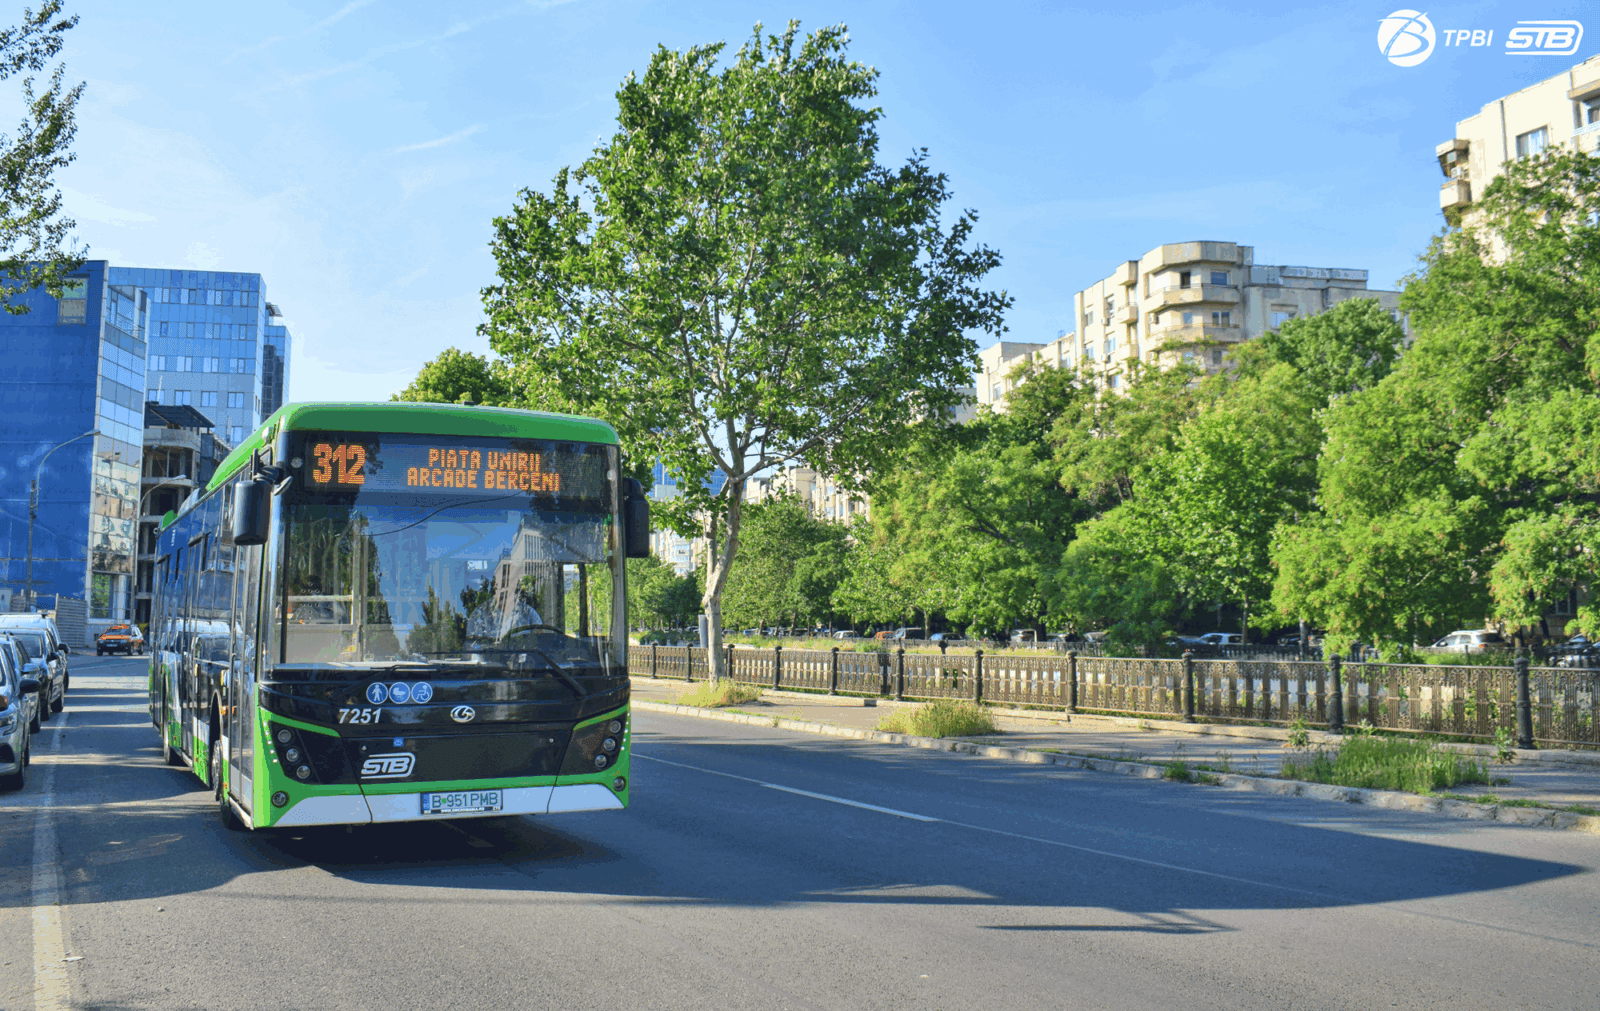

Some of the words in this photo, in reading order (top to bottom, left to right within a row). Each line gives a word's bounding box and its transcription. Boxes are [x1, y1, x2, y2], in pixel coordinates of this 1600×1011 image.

[313, 443, 366, 484] 312
[428, 448, 482, 469] PIATA
[487, 451, 541, 472] UNIRII
[407, 467, 478, 488] ARCADE
[484, 470, 560, 491] BERCENI
[339, 707, 382, 724] 7251
[361, 756, 411, 776] STB
